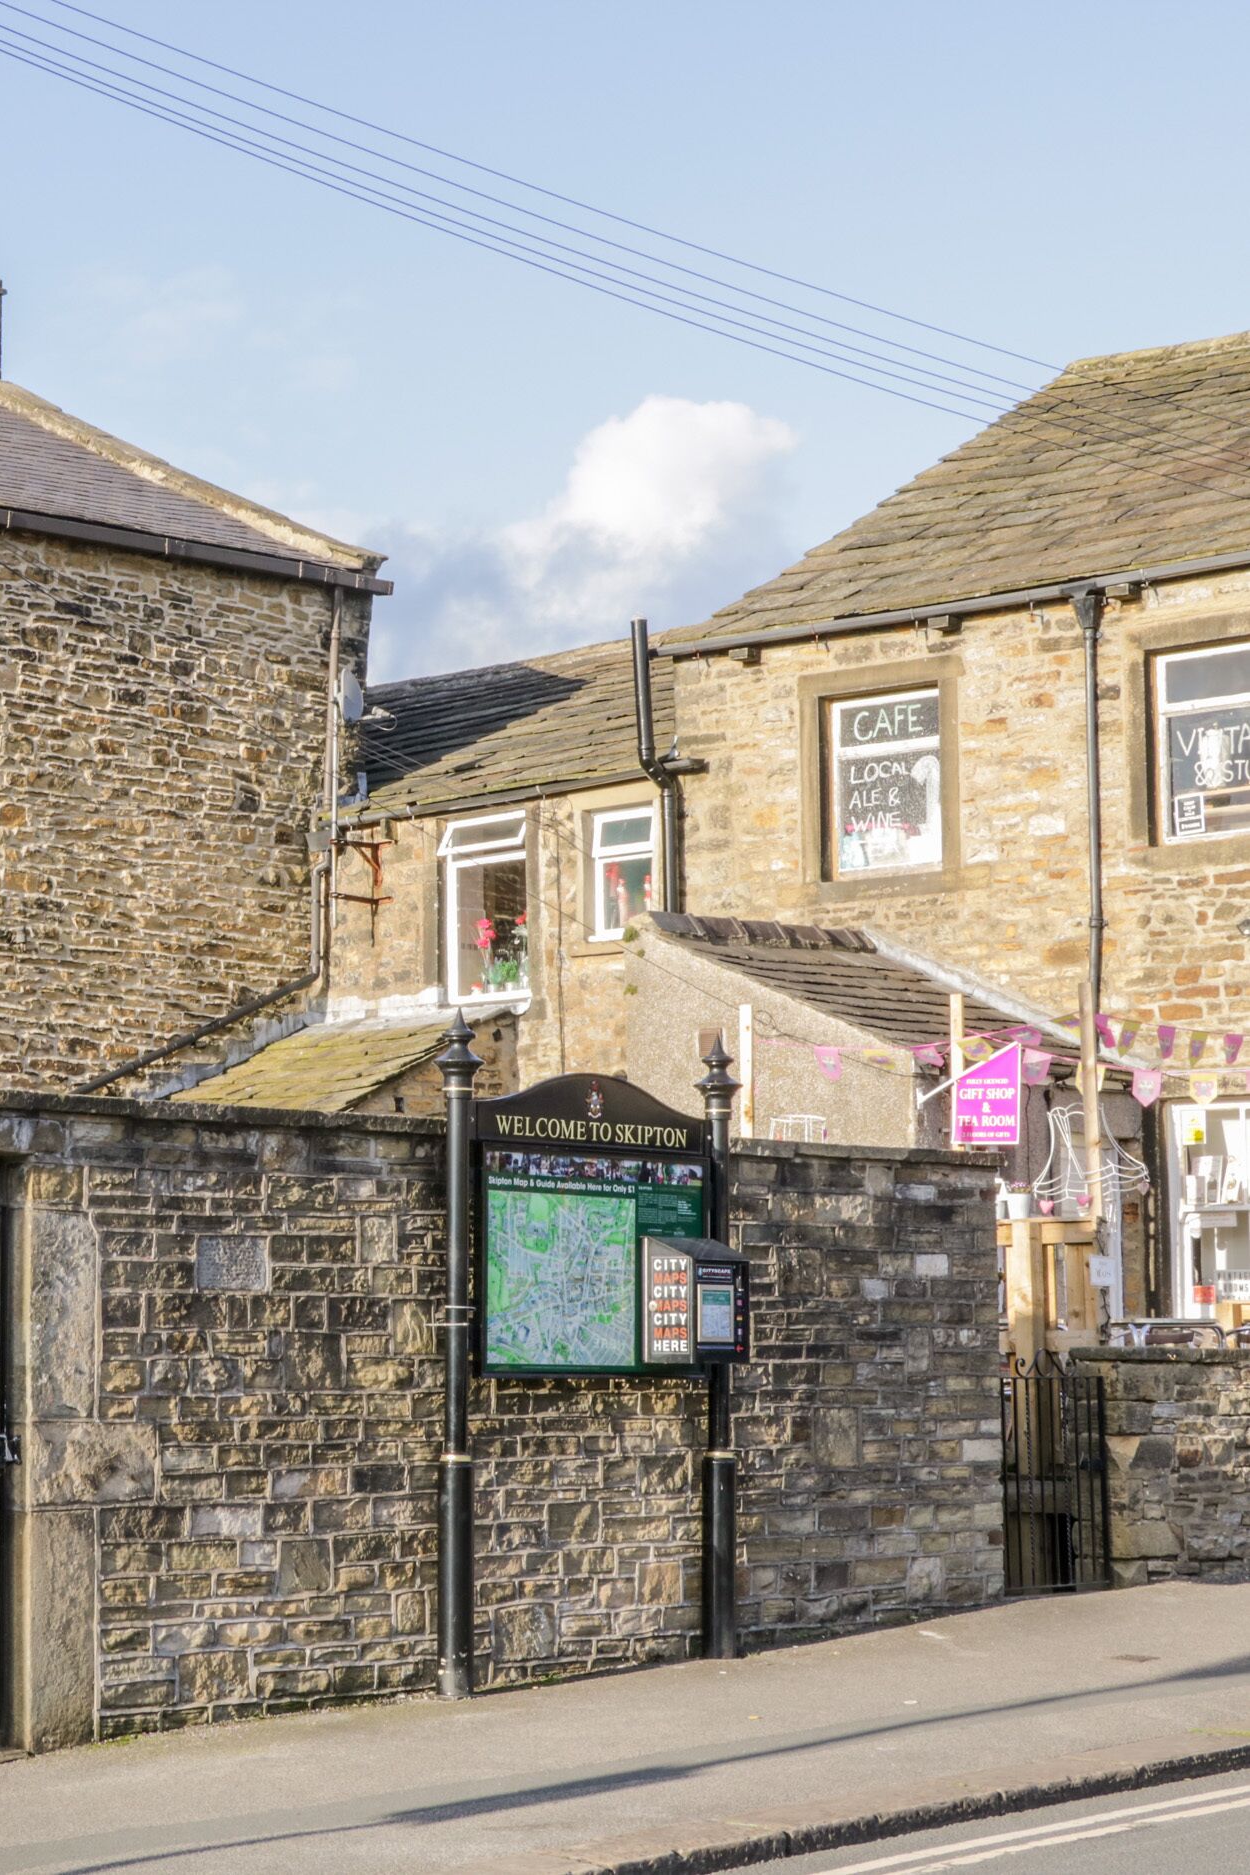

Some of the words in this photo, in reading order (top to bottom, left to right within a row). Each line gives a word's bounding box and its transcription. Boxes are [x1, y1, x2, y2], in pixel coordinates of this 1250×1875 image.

[853, 703, 923, 741] CAFE
[849, 761, 911, 785] LOCAL
[849, 788, 882, 810] ALE
[888, 786, 901, 807] &
[851, 811, 903, 833] WINE
[959, 1088, 985, 1100] GIFT
[986, 1087, 1015, 1100] SHOP
[981, 1101, 991, 1113] &
[958, 1115, 978, 1127] TEA
[981, 1115, 1015, 1127] ROOM
[495, 1114, 587, 1141] WELCOME
[589, 1121, 612, 1142] TO
[615, 1123, 687, 1148] SKIPTON
[488, 1175, 512, 1186] Skipton
[513, 1177, 528, 1188] Map
[536, 1179, 556, 1188] Guide
[556, 1181, 587, 1190] Available
[587, 1182, 602, 1191] Here
[603, 1184, 612, 1192] for
[612, 1184, 627, 1194] Only
[653, 1258, 687, 1271] CITY
[653, 1271, 687, 1285] MAPS
[653, 1285, 687, 1299] CITY
[653, 1313, 687, 1326] CITY
[653, 1326, 687, 1340] MAPS
[653, 1339, 688, 1352] HERE
